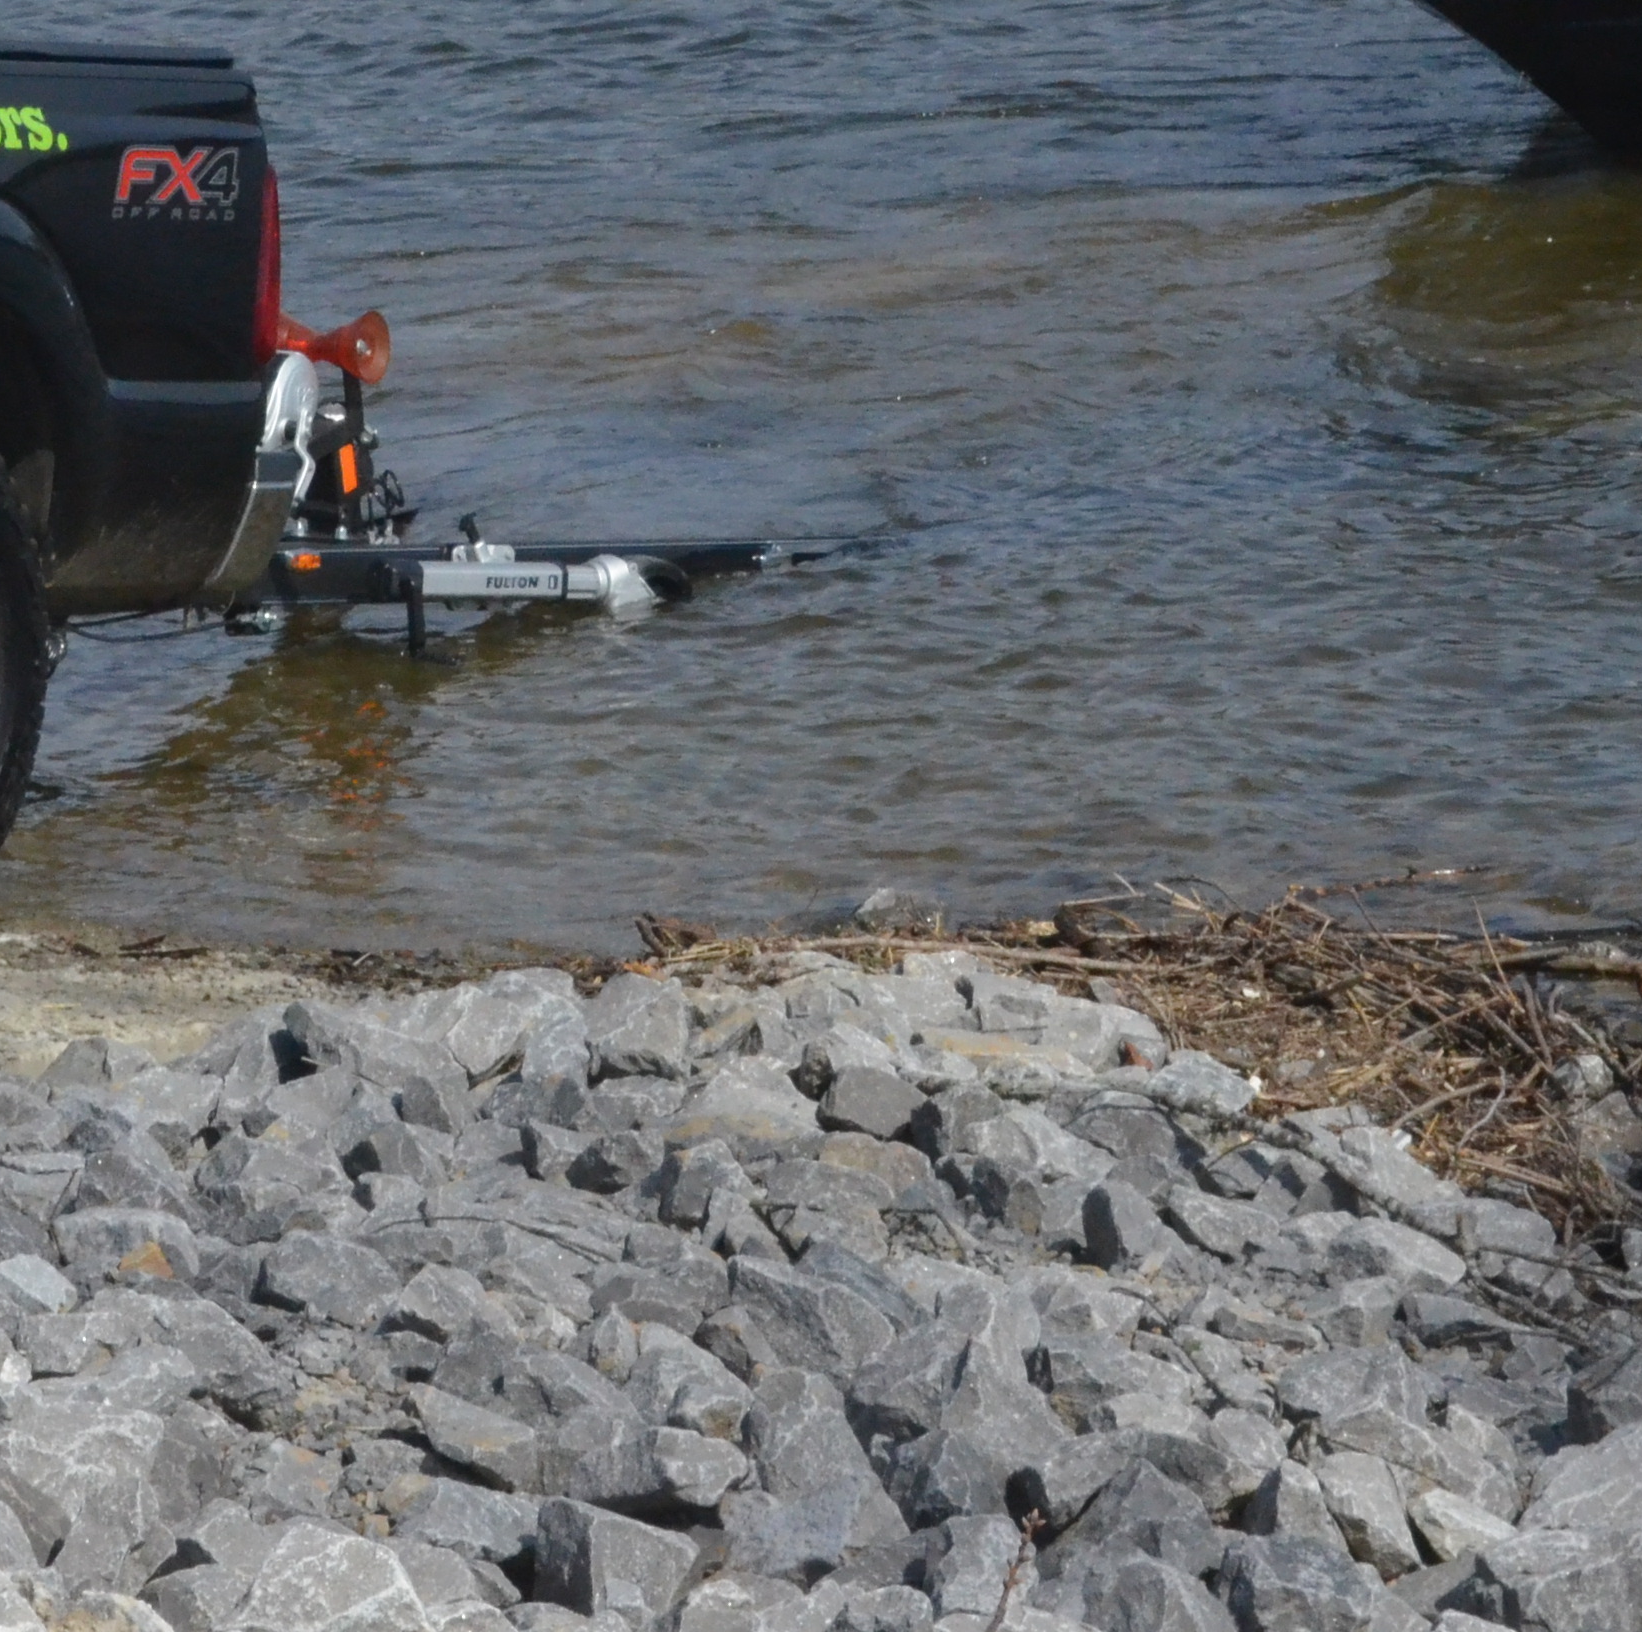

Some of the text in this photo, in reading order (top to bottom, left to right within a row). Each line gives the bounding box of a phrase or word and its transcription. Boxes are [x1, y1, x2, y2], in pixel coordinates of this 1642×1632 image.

[113, 144, 240, 206] FX4
[111, 206, 236, 222] OFF ROAD
[485, 576, 539, 589] FULTON
